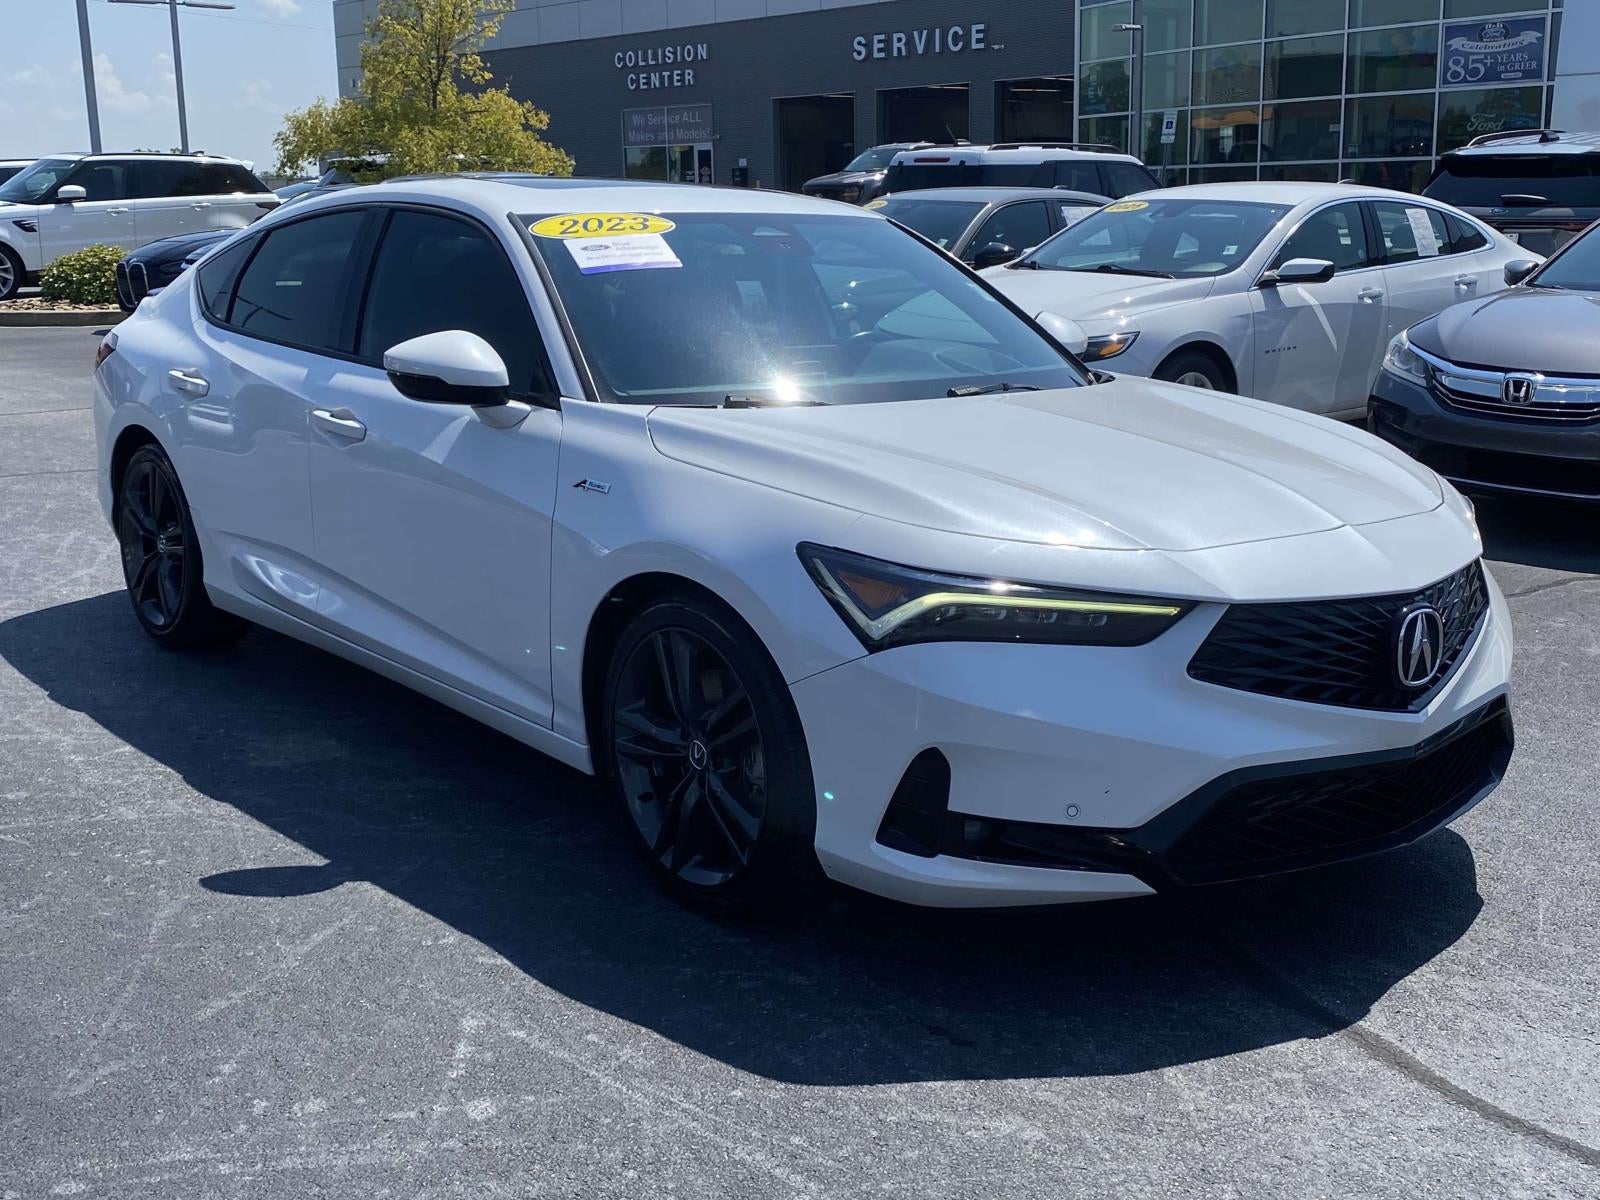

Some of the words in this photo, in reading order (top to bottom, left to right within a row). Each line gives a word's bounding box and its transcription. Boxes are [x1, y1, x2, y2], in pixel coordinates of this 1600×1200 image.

[852, 23, 985, 61] SERVICE
[1461, 38, 1525, 51] Celebrating
[614, 43, 707, 68] COLLISION
[1497, 52, 1528, 63] YEARS
[1496, 63, 1505, 72] in
[1507, 60, 1537, 71] GREER
[627, 69, 694, 90] CENTER
[632, 113, 645, 126] We
[682, 111, 702, 123] ALL
[1466, 112, 1505, 131] Ford
[559, 216, 650, 235] 2023
